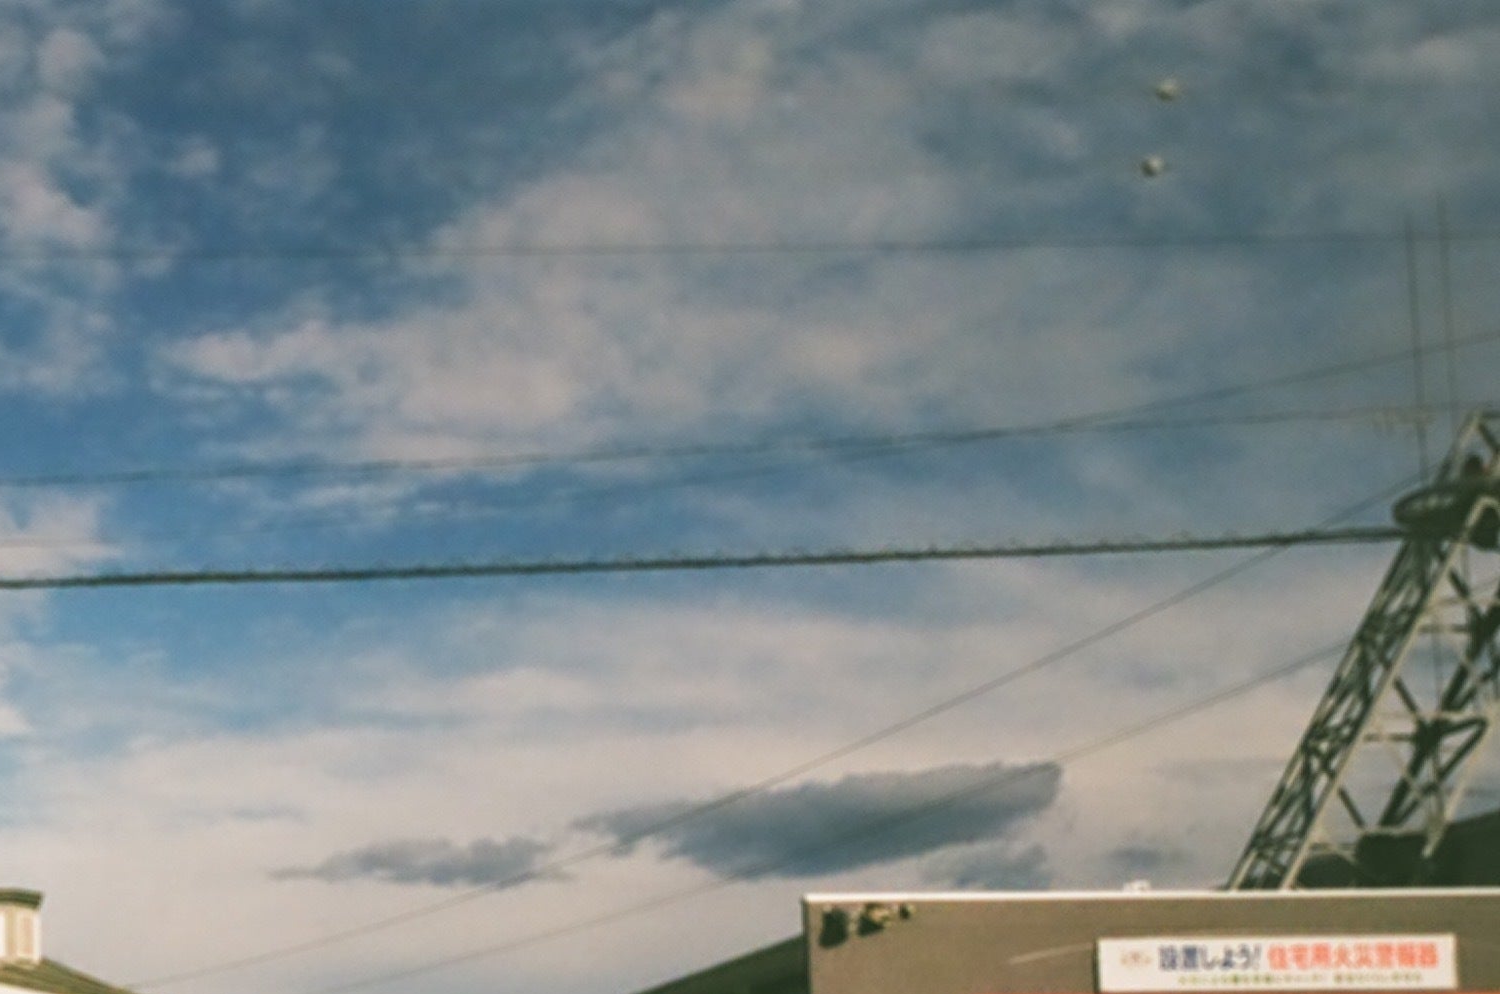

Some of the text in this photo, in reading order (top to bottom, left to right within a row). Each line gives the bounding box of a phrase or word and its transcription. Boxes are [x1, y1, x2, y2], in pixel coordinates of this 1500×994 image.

[1267, 942, 1439, 970] 住宅用火災警報器
